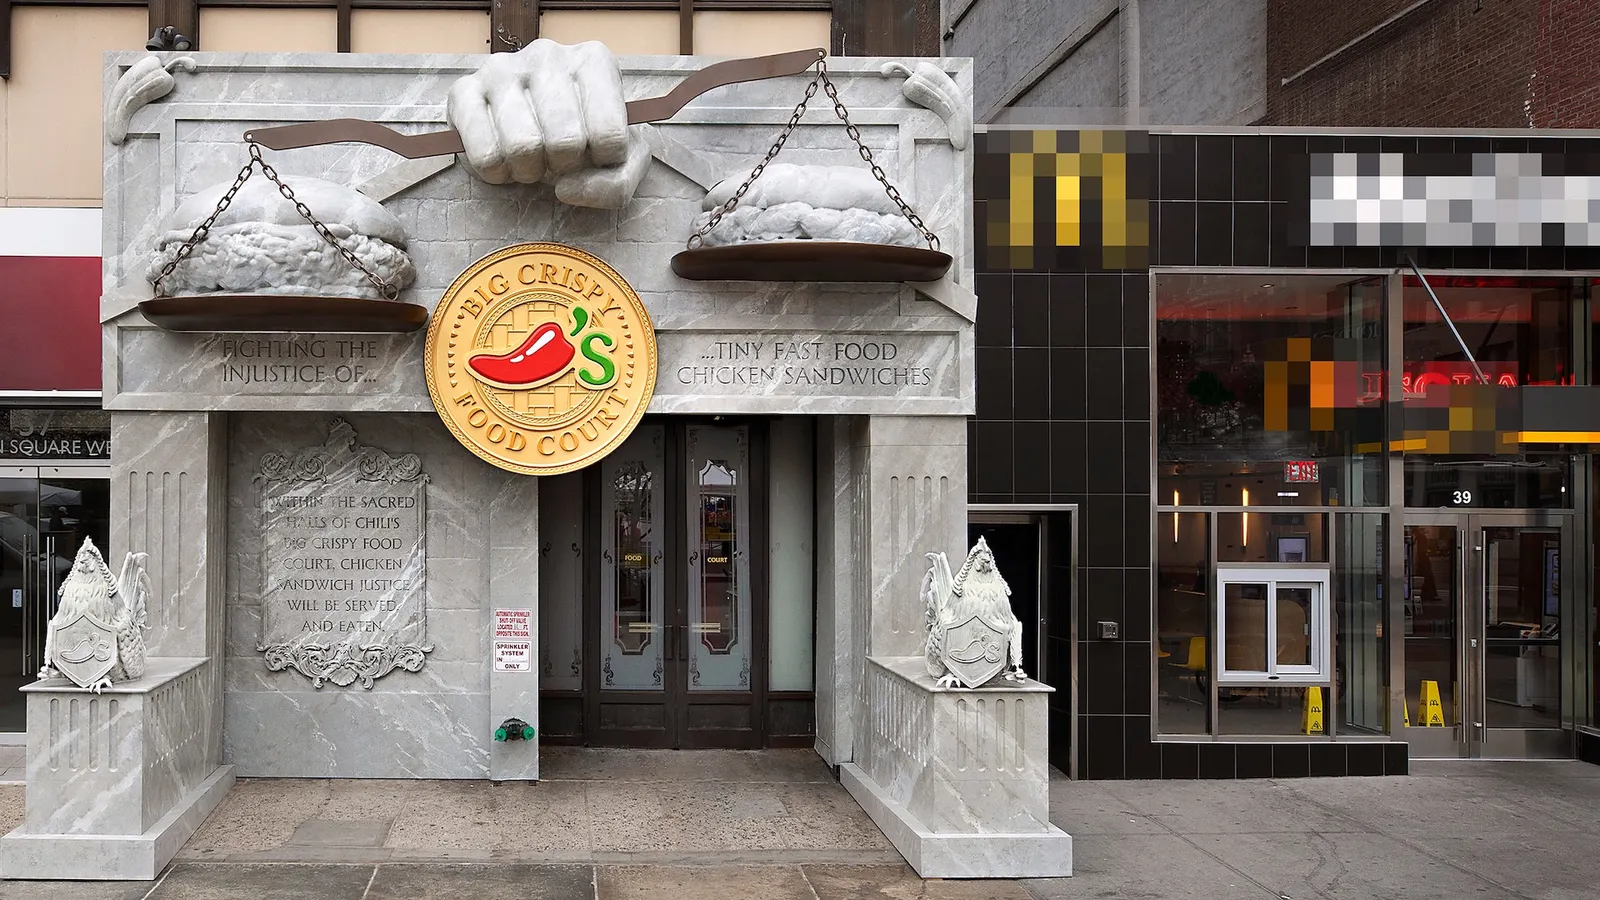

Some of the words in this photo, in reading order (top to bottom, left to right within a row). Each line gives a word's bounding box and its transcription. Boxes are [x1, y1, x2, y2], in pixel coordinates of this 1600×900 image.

[461, 272, 510, 319] BIG
[517, 263, 622, 319] CRISPY
[222, 340, 326, 358] FIGHTING
[336, 340, 377, 358] THE
[701, 342, 763, 360] ...TINY
[774, 342, 823, 360] FAST
[834, 342, 897, 361] FOOD
[223, 365, 325, 384] INJUSTICE
[335, 365, 377, 383] OF...
[676, 366, 775, 385] CHICKEN
[784, 366, 931, 385] SANDWICHES
[453, 389, 527, 452] FOOD
[537, 388, 628, 456] COURT
[10, 440, 81, 456] SQUARE
[268, 496, 323, 508] WITHIN
[330, 496, 356, 508] THE
[361, 496, 415, 509] SACRED
[1453, 490, 1471, 504] 39
[287, 517, 326, 529] HALLS
[332, 517, 350, 529] OF
[355, 517, 400, 529] CHILI'S
[284, 537, 306, 549] BIG
[314, 537, 357, 549] CRISPY
[363, 537, 402, 549] FOOD
[283, 558, 335, 572] COURT,
[341, 558, 402, 570] CHICKEN
[277, 579, 353, 591] SANDWICH
[360, 579, 410, 592] JUSTICE
[287, 600, 319, 611] WILL
[325, 600, 340, 611] BE
[301, 620, 333, 632] AND
[339, 620, 385, 632] EATEN.
